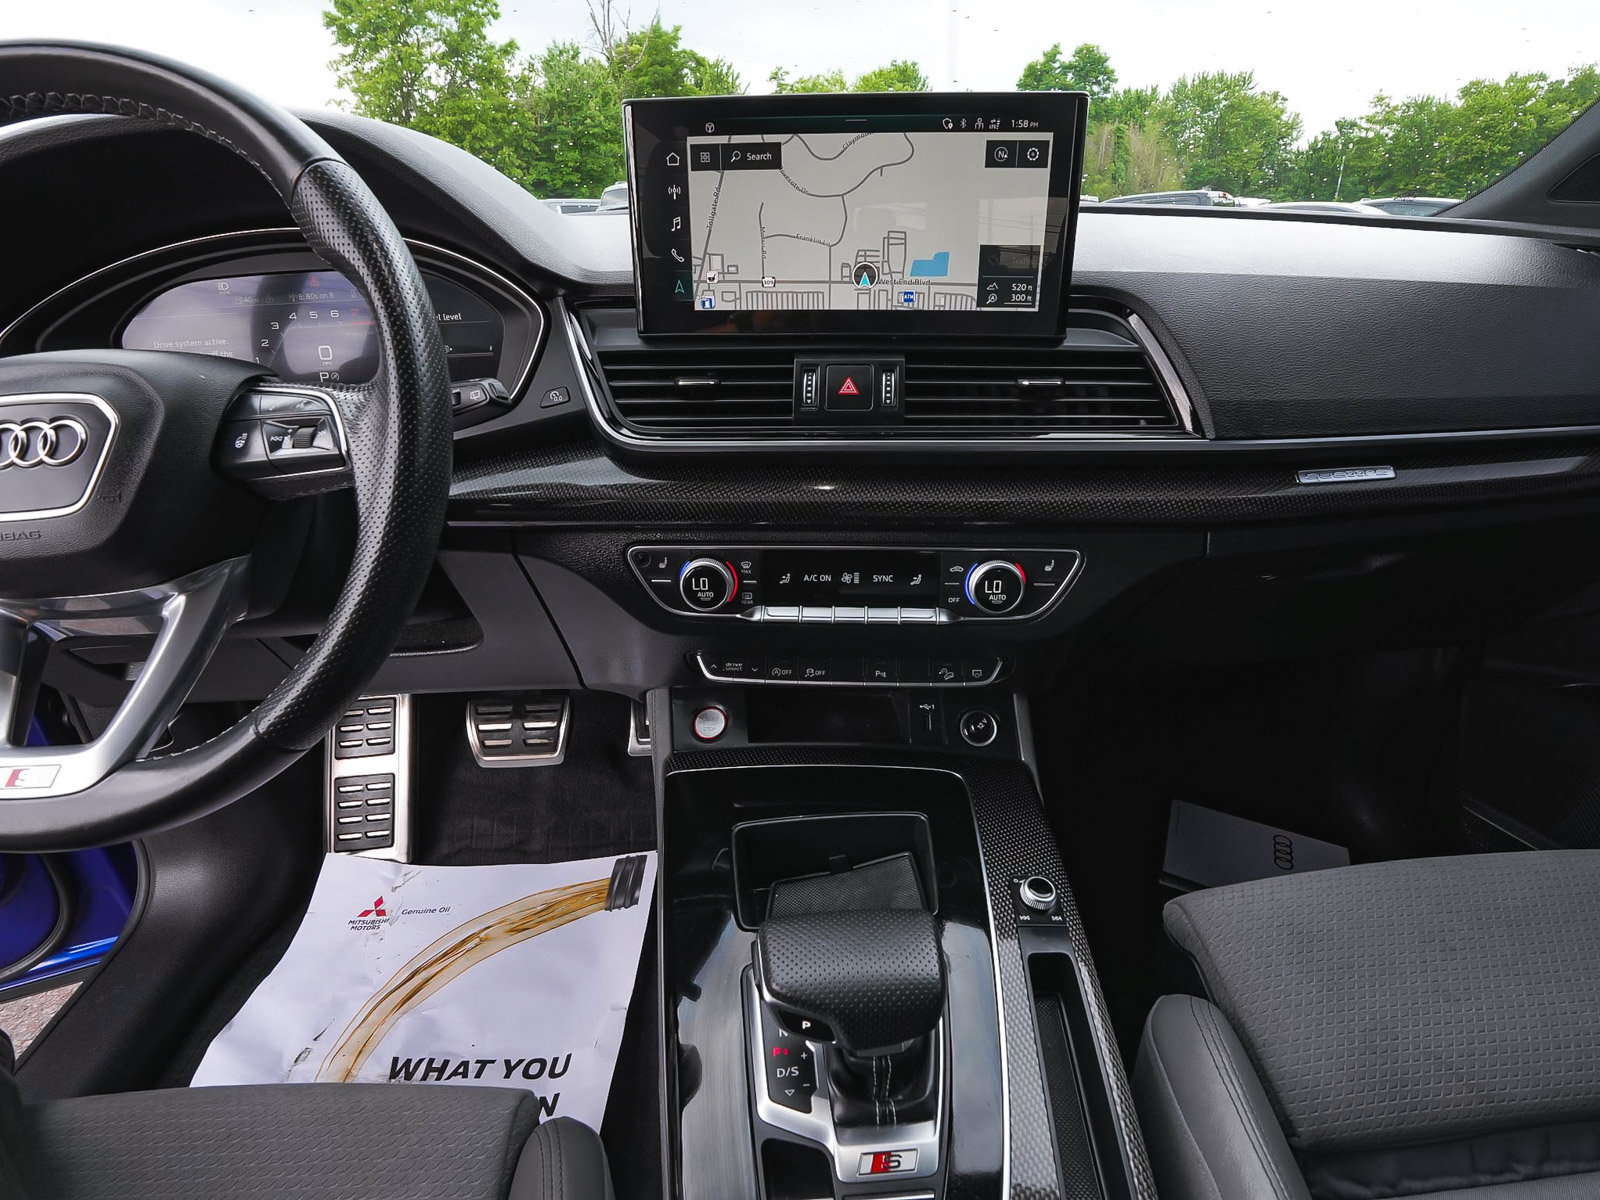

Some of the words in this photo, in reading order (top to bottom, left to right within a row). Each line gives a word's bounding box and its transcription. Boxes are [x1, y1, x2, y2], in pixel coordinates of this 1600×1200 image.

[1011, 119, 1029, 129] 1:58
[746, 151, 772, 161] Search
[898, 278, 913, 286] End
[914, 278, 931, 286] Blvd
[1011, 283, 1027, 291] 520
[1010, 293, 1026, 302] 300
[288, 311, 298, 321] 4
[309, 310, 319, 319] 5
[330, 309, 340, 318] 6
[443, 312, 462, 321] level
[270, 321, 280, 330] 3
[260, 339, 270, 347] 2
[319, 371, 330, 383] P
[803, 574, 818, 582] A/C
[819, 574, 832, 582] ON
[872, 574, 894, 583] SYNC
[692, 577, 709, 591] LO
[984, 580, 1002, 594] LO
[697, 591, 714, 599] AUTO
[401, 906, 437, 915] Genuine
[438, 905, 451, 914] Oil
[347, 918, 390, 926] MITSUBISHI
[349, 924, 381, 932] MOTORS
[802, 1020, 811, 1030] P
[388, 1056, 497, 1082] WHAT
[503, 1052, 573, 1080] YOU
[776, 1066, 799, 1079] D/S
